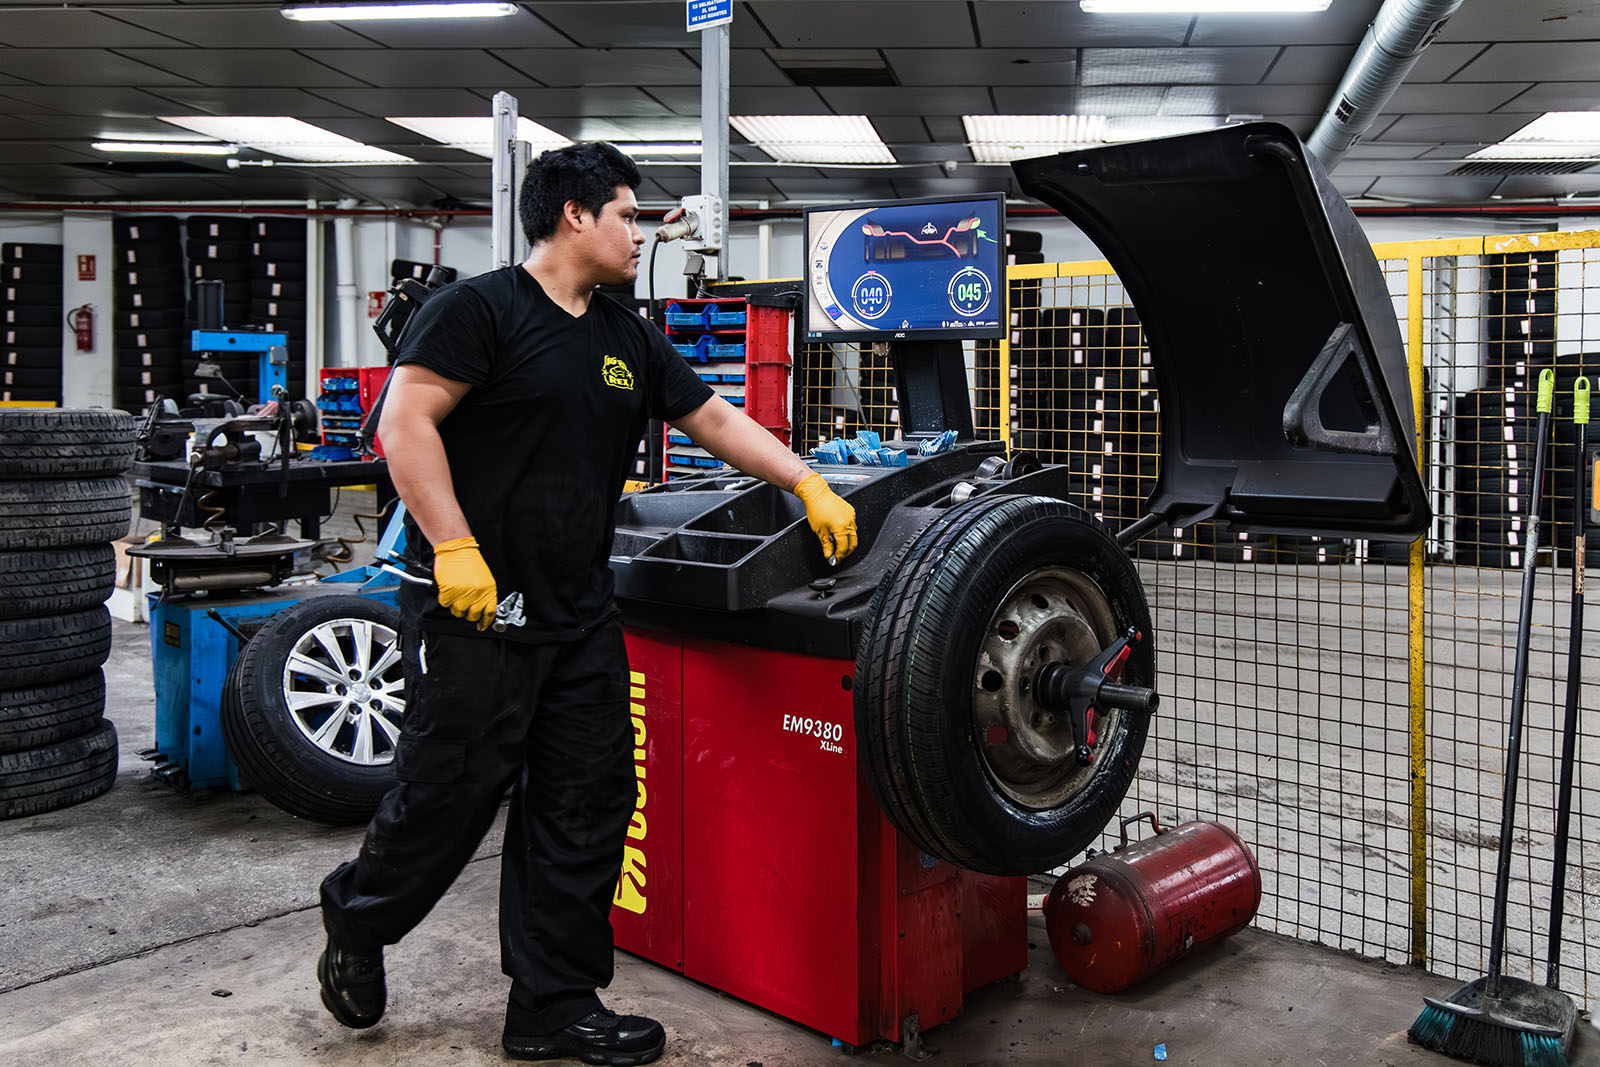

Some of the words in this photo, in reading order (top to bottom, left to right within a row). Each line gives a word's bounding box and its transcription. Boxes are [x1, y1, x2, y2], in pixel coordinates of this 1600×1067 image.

[708, 9, 728, 18] GUANTES
[861, 288, 882, 304] 040
[958, 282, 982, 302] 045
[608, 374, 630, 386] REX
[782, 714, 842, 742] EM9380
[820, 740, 843, 754] XLine
